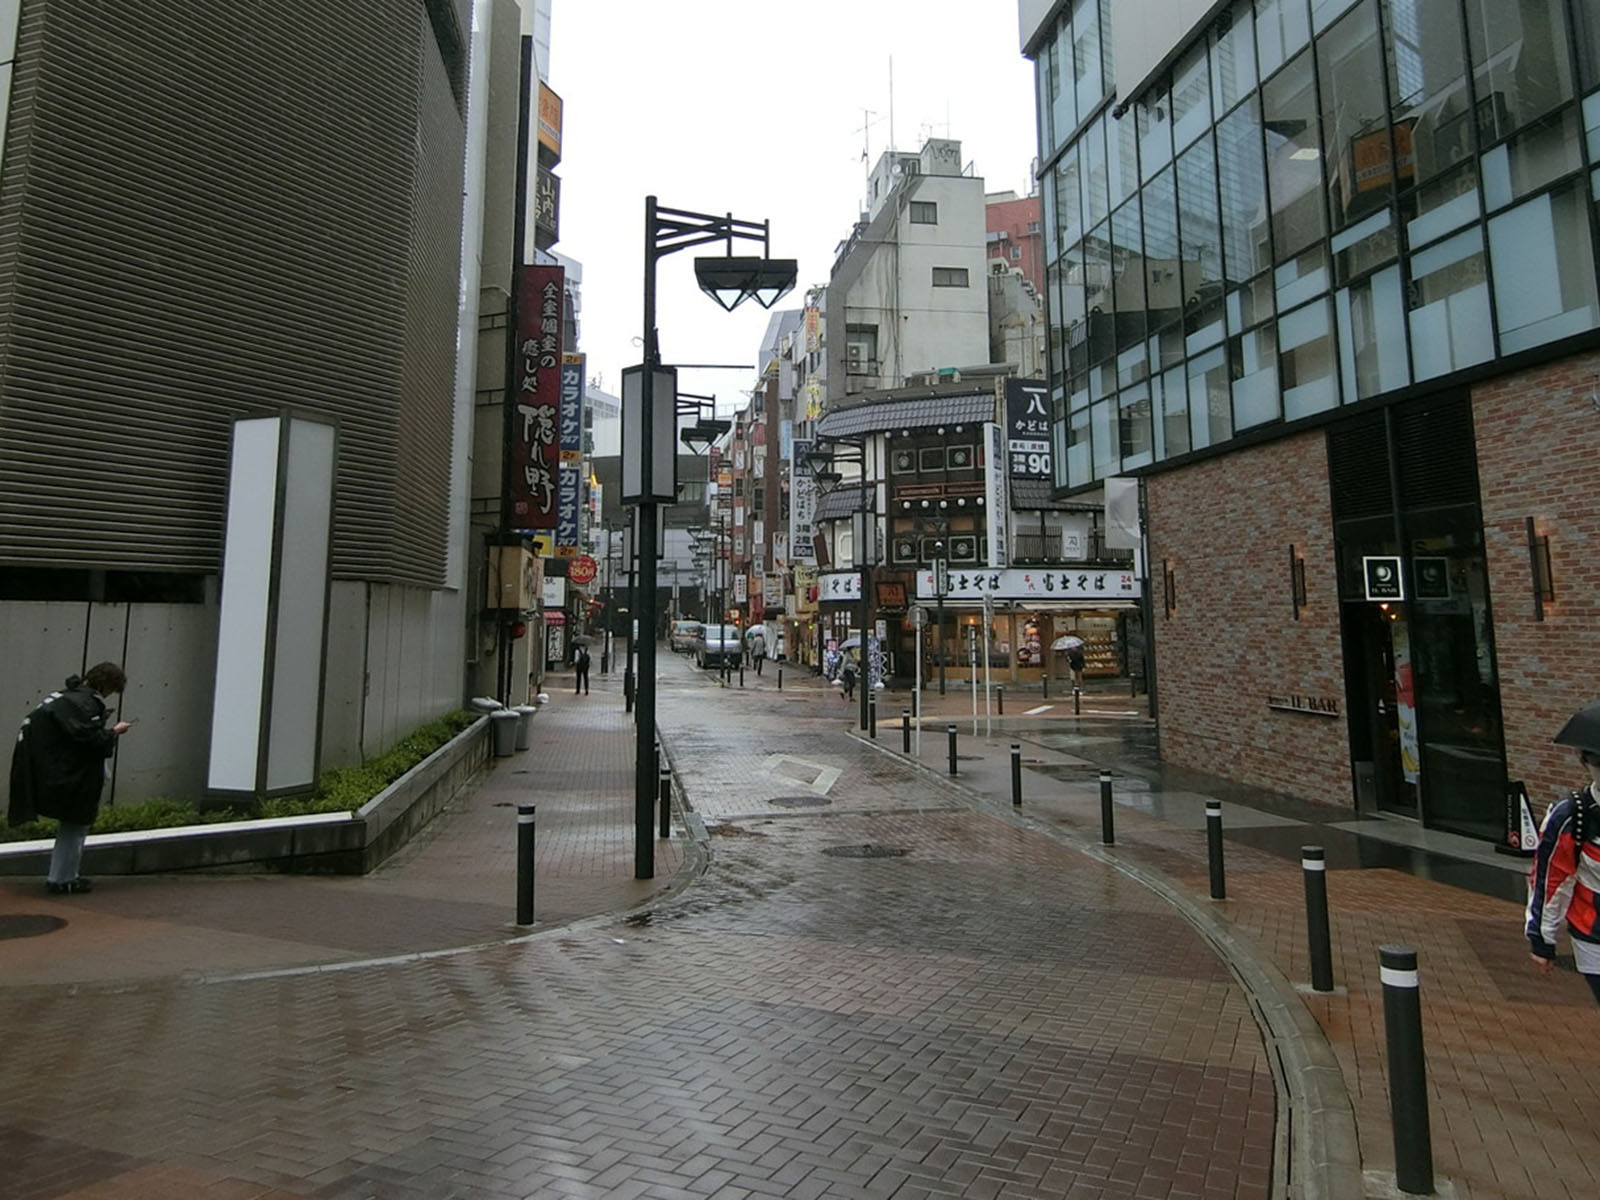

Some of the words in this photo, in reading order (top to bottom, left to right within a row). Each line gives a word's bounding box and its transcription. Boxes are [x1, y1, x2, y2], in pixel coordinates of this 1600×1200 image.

[540, 282, 558, 368] 全室個室の
[521, 338, 541, 393] 癒し処
[562, 370, 580, 434] カラオケ
[1028, 453, 1050, 475] 90
[558, 470, 577, 536] カラオケ
[796, 479, 806, 520] かどはち
[1043, 572, 1108, 592] 富士そば
[1120, 575, 1132, 583] 24
